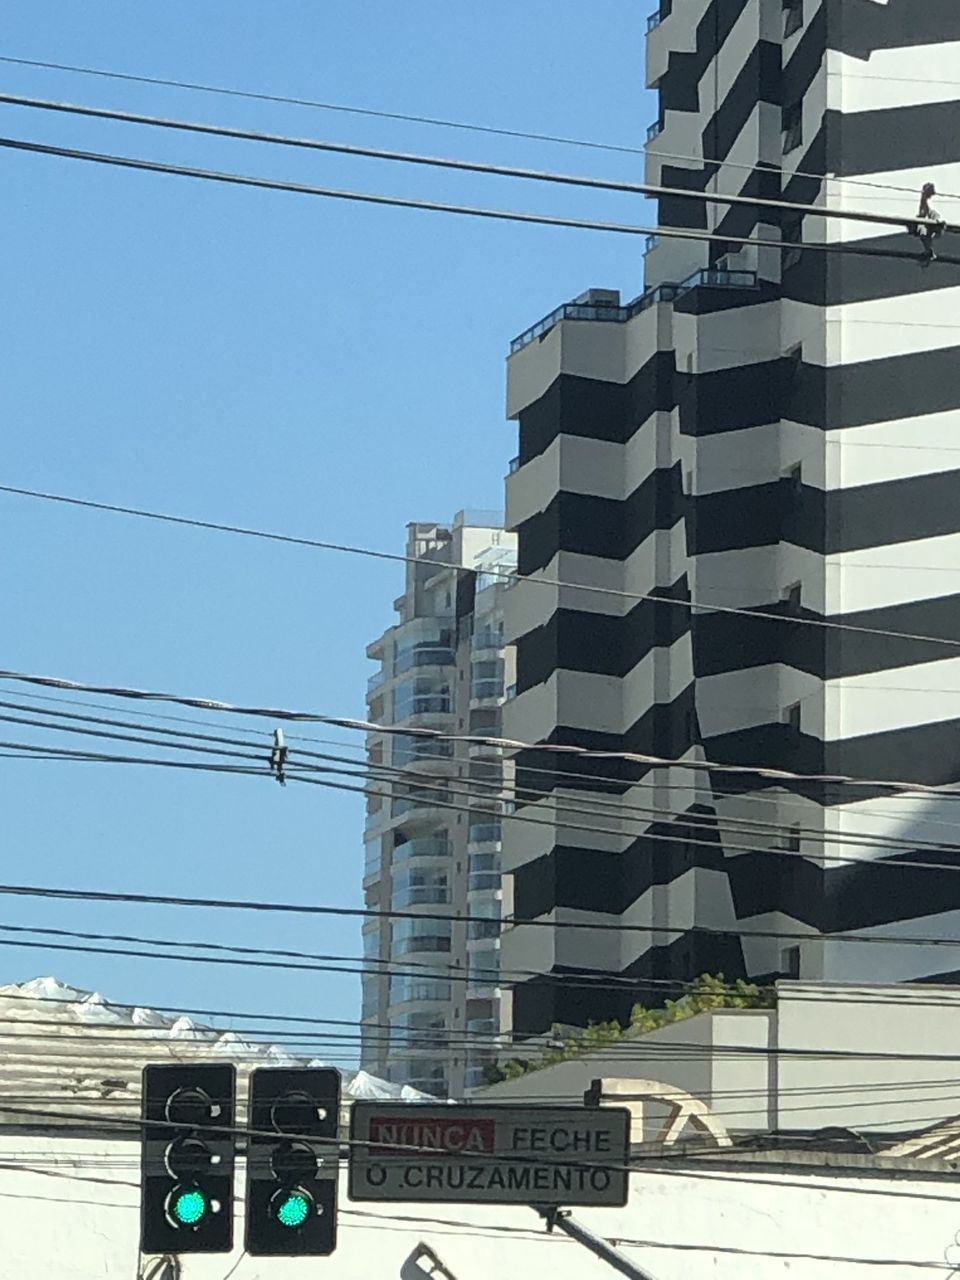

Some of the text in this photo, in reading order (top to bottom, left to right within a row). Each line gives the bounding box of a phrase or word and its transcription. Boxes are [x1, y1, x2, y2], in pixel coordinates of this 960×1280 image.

[377, 1124, 612, 1153] NUNCA FECHE
[366, 1164, 611, 1192] O CRUZAMENTO
